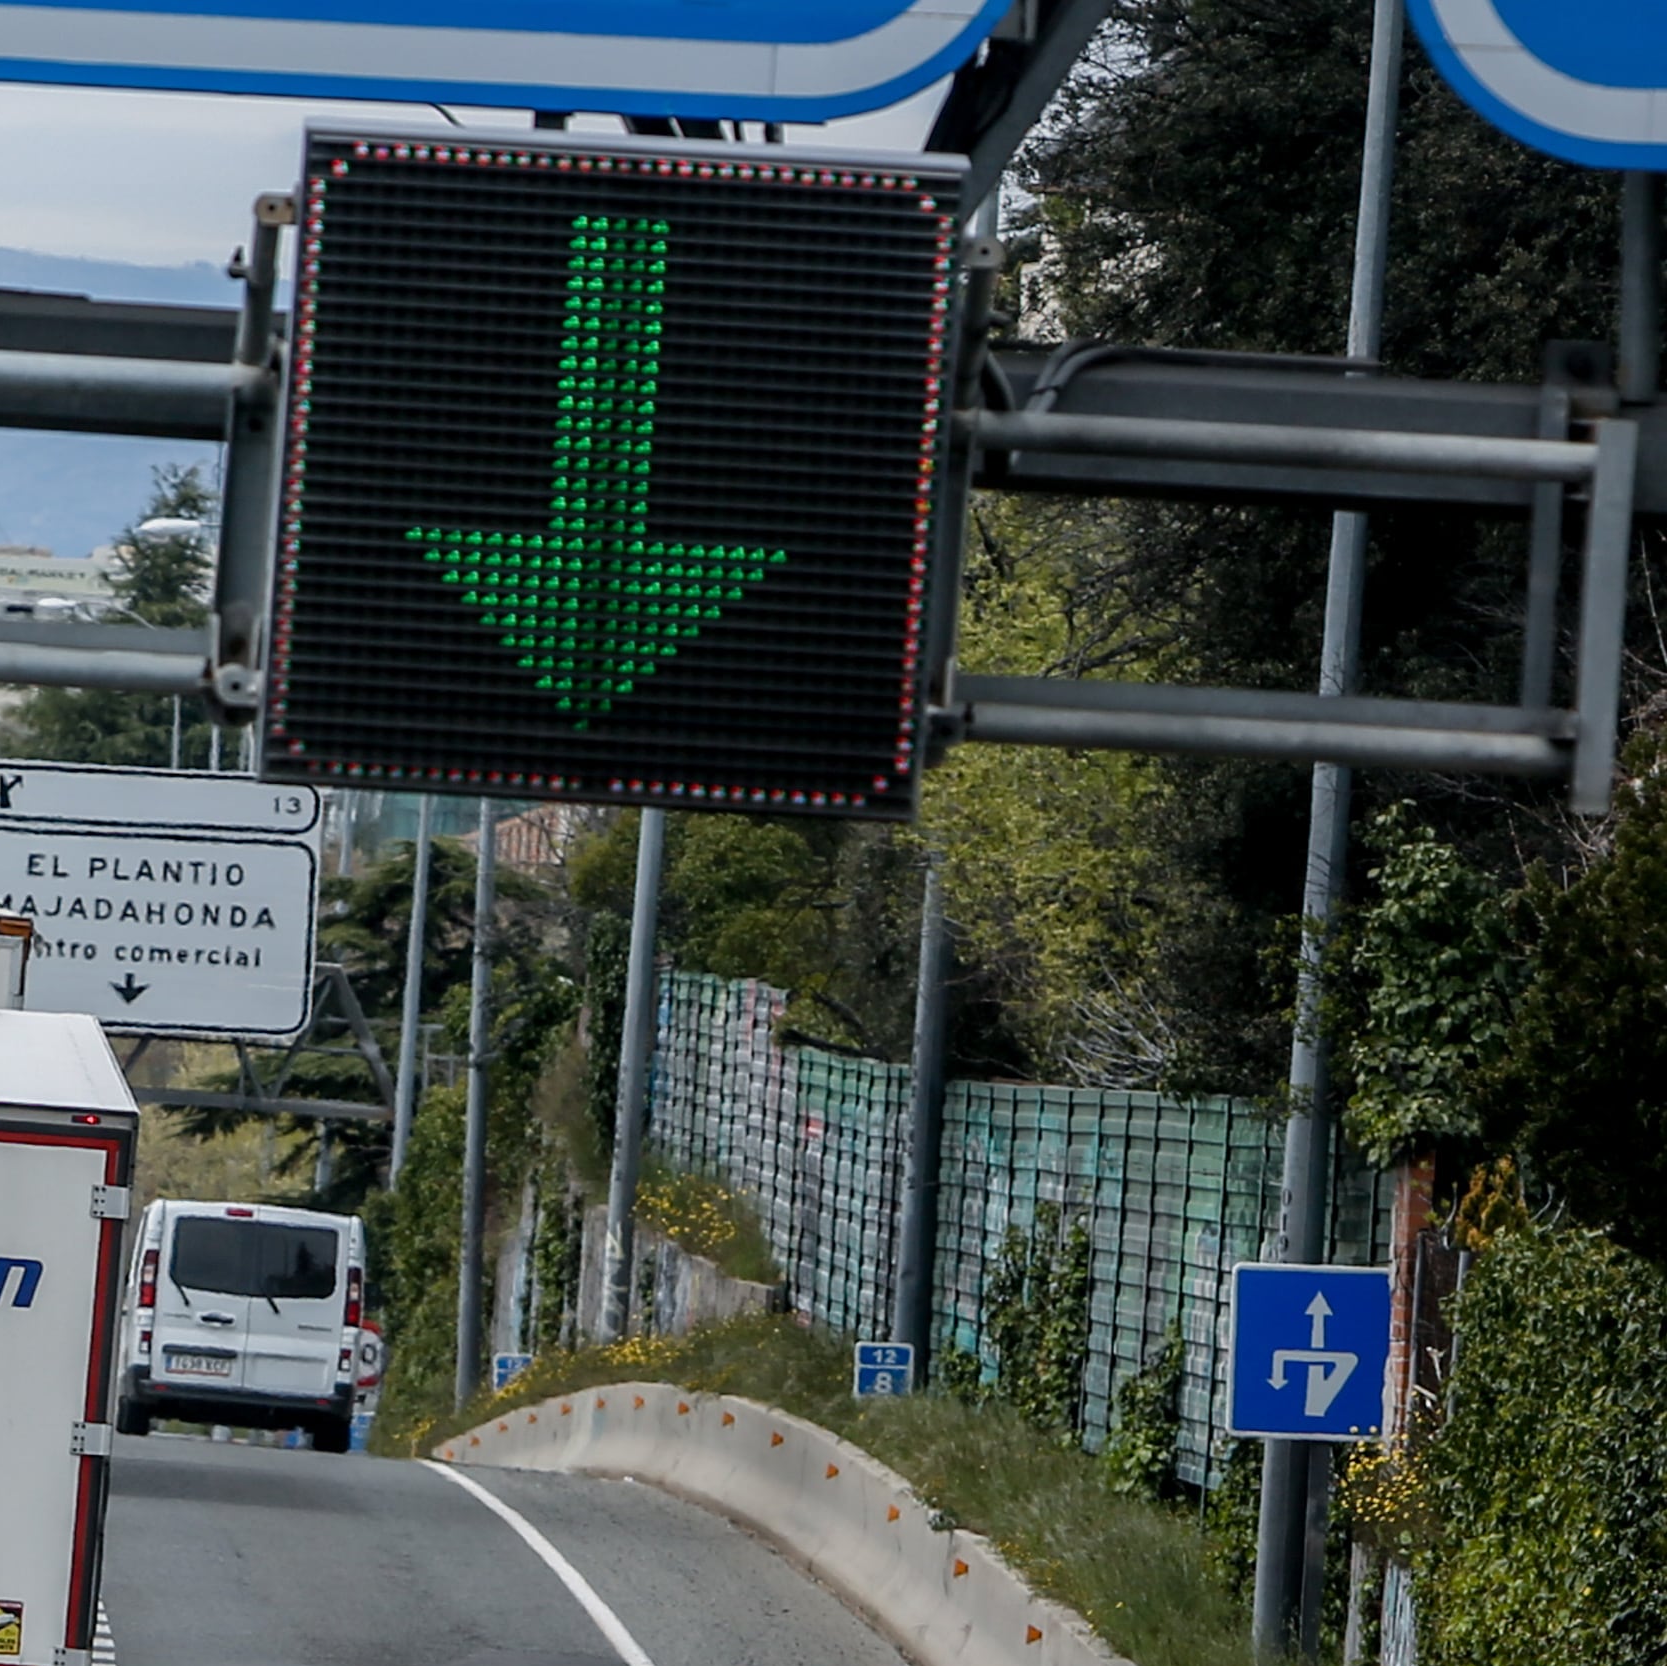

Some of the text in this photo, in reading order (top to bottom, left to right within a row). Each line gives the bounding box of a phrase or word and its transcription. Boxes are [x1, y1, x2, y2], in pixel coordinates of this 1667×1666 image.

[27, 568, 86, 579] MARKET
[273, 796, 302, 814] 13
[26, 853, 245, 887] EL PLANTIO
[113, 942, 262, 968] comercial
[872, 1349, 897, 1364] 12
[874, 1371, 892, 1393] 8
